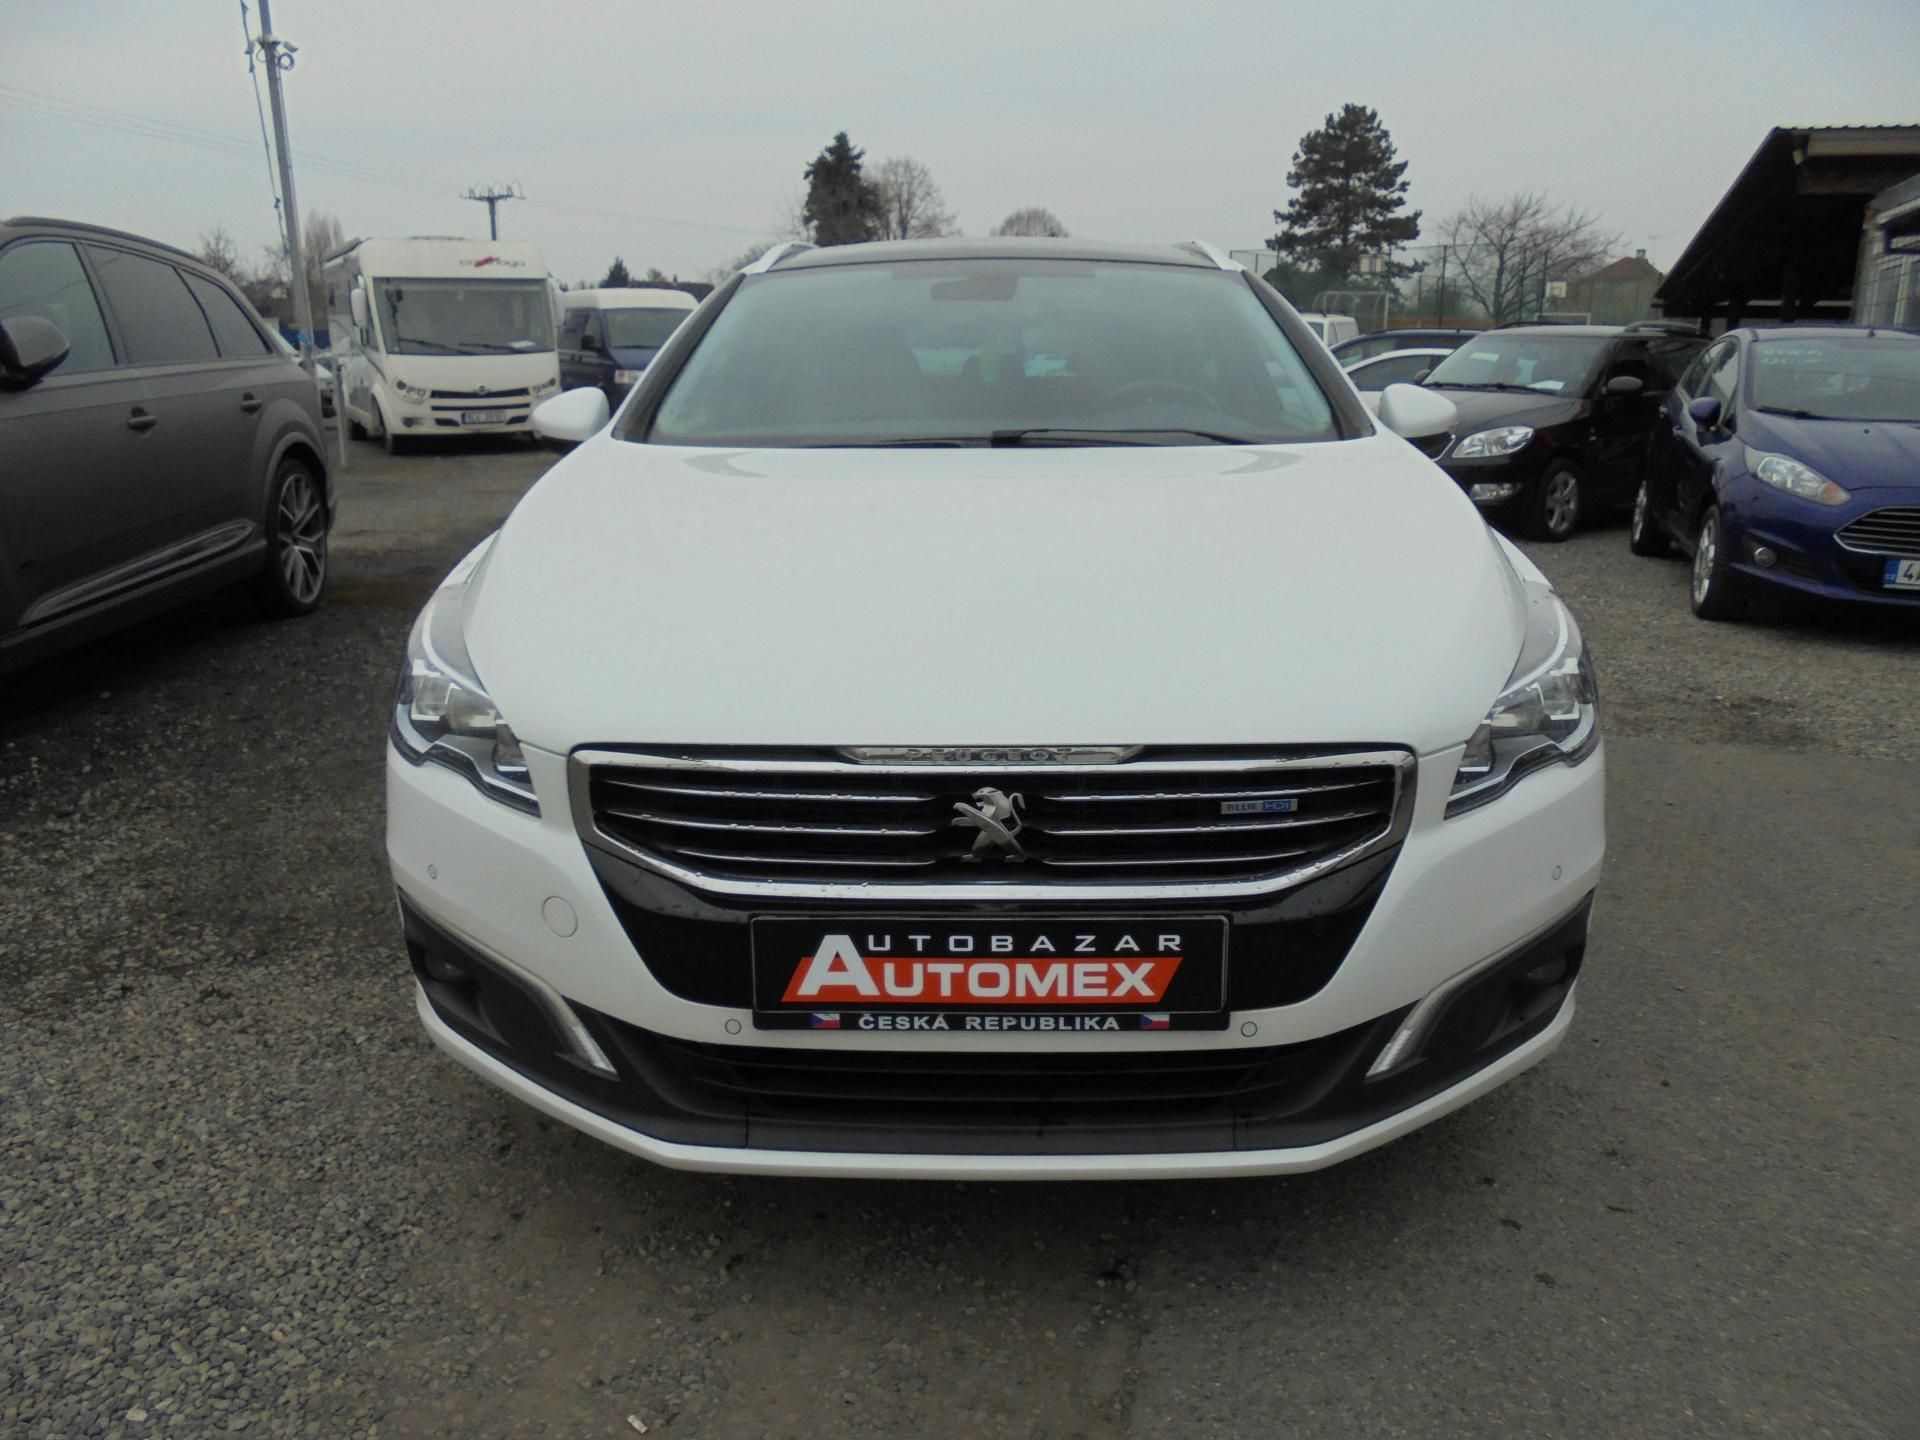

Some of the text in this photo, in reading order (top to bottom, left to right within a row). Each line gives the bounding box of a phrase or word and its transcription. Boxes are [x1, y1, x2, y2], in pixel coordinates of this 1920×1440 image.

[1903, 562, 1920, 582] 4
[1227, 803, 1257, 812] BLUE
[797, 934, 1155, 997] AUTOMEX
[858, 1012, 1120, 1030] ČESKÁ REPUBLIKA
